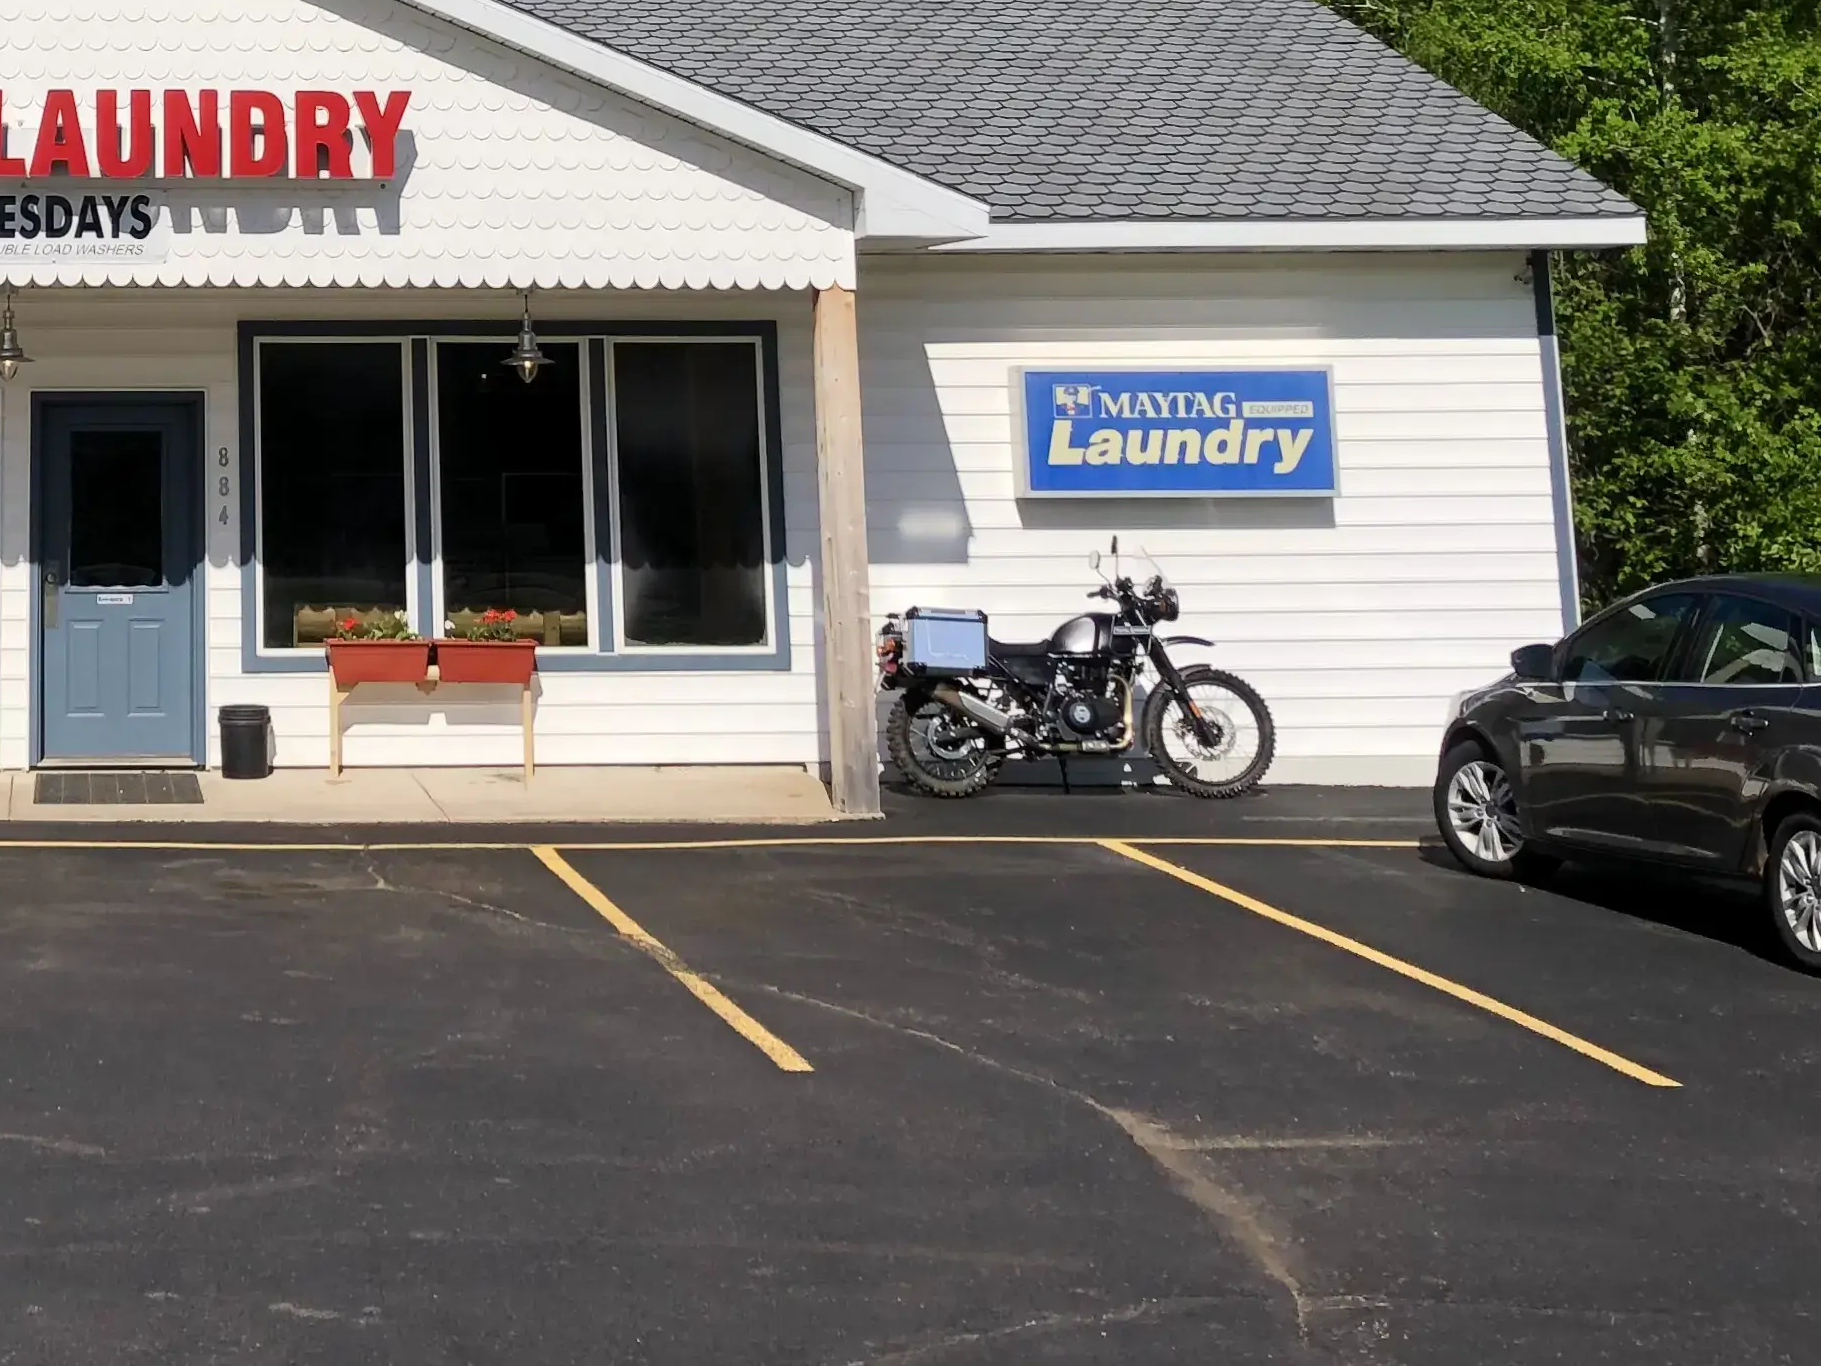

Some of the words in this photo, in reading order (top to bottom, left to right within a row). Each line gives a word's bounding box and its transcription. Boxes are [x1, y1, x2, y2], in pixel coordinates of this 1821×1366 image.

[34, 244, 73, 256] LOAD
[76, 244, 145, 256] WASHERS
[1098, 392, 1237, 418] MAYTAG
[1248, 404, 1310, 415] EQUIPPED
[1047, 419, 1315, 475] Laundry
